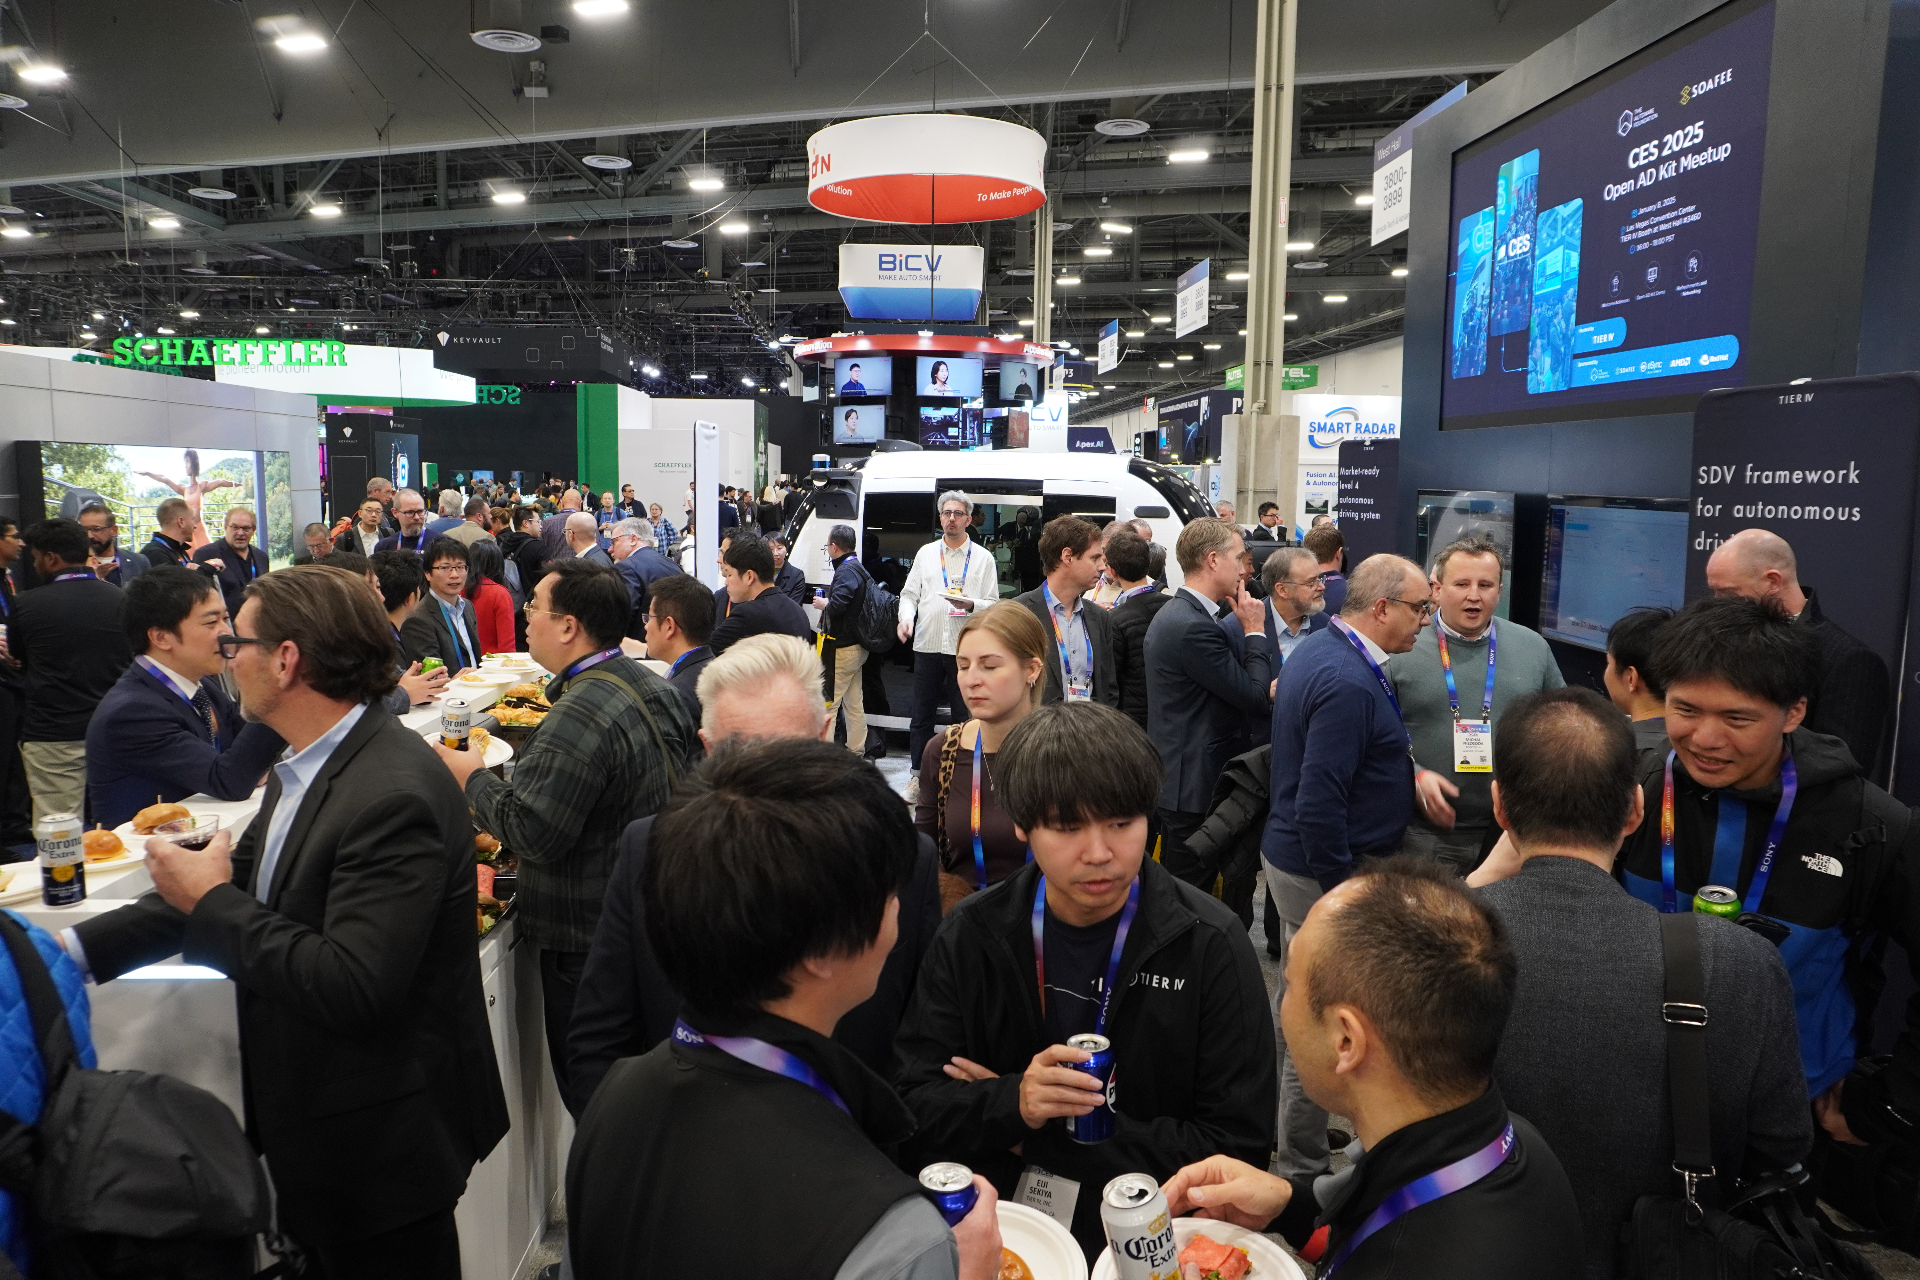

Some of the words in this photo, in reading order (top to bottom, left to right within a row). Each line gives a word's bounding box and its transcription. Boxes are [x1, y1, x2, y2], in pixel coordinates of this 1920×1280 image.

[1691, 68, 1734, 98] SOAFEE
[1377, 143, 1391, 162] West
[1390, 135, 1402, 153] Hall
[1628, 140, 1659, 169] CES
[1661, 120, 1704, 157] 2025
[1383, 165, 1407, 192] 3800-
[1603, 179, 1635, 202] Open
[1636, 168, 1657, 190] AD
[1658, 160, 1678, 181] Kit
[1679, 142, 1732, 174] Meetup
[977, 193, 988, 202] To
[989, 189, 1011, 201] Make
[1383, 186, 1403, 211] 3899
[1626, 224, 1635, 233] Las
[1635, 219, 1650, 230] Vegas
[1649, 210, 1678, 225] Convention
[1678, 205, 1696, 216] Center
[1507, 233, 1532, 257] CES
[878, 253, 943, 272] BiCV
[919, 274, 942, 282] SMART
[1592, 334, 1608, 344] TIER
[112, 336, 348, 367] SCHAEFFLER
[1669, 357, 1688, 368] AMD
[1227, 369, 1244, 382] AUTEL
[1779, 394, 1802, 405] TIER
[1804, 392, 1815, 402] IV
[1309, 421, 1352, 434] SMART
[1354, 422, 1396, 435] RADAR
[1075, 440, 1104, 449] Apex.AI
[1339, 466, 1380, 477] Market-ready
[1698, 465, 1736, 484] SDV
[1745, 461, 1861, 484] framework
[1339, 480, 1354, 490] level
[1355, 481, 1359, 490] 4
[1339, 496, 1374, 505] autonomous
[1339, 509, 1359, 521] driving
[1360, 511, 1381, 522] system
[1696, 497, 1722, 517] for
[1733, 502, 1861, 521] autonomous
[440, 714, 469, 728] Corona
[444, 725, 462, 734] Extra
[37, 836, 82, 854] Corona
[49, 849, 76, 859] Extra
[1760, 841, 1777, 873] SONY
[1815, 852, 1831, 862] THE
[1801, 855, 1830, 868] NORTH
[1807, 862, 1830, 874] FACE
[1140, 972, 1170, 990] TIER
[1173, 978, 1186, 991] IV
[1036, 1179, 1049, 1189] EIJI
[1029, 1186, 1053, 1199] SEKIYA
